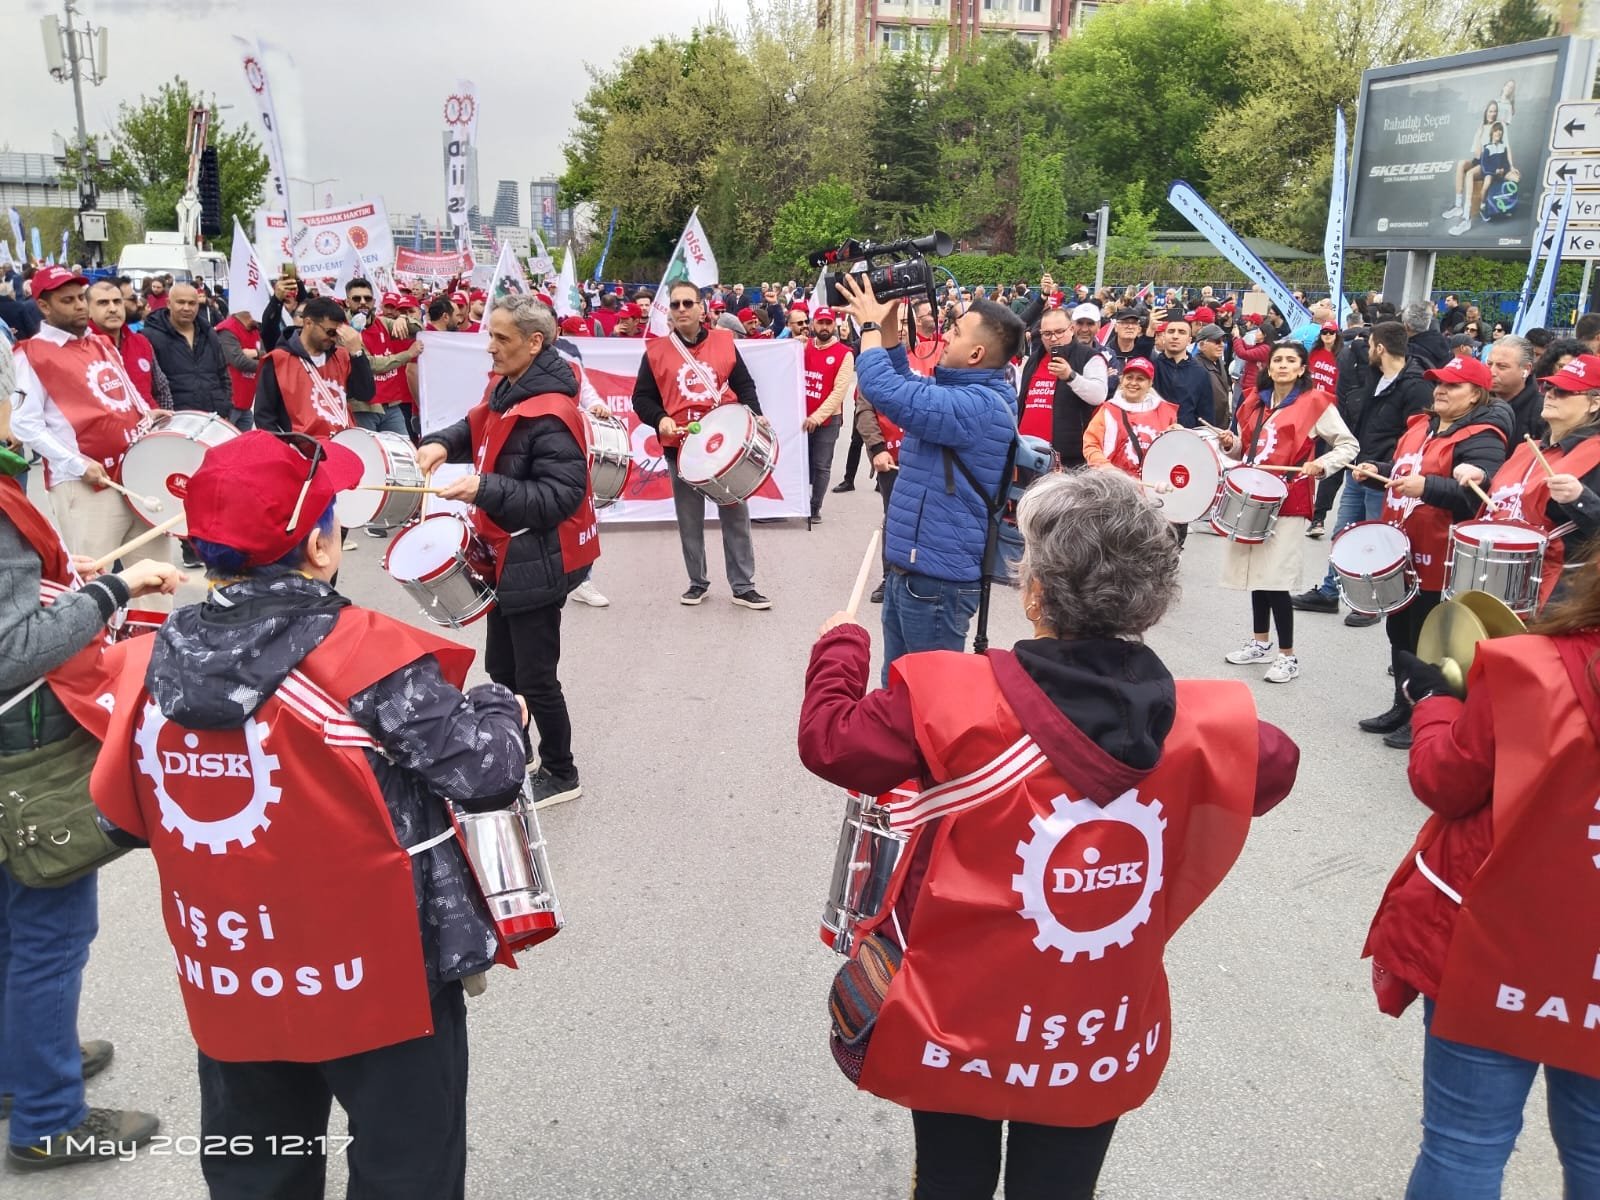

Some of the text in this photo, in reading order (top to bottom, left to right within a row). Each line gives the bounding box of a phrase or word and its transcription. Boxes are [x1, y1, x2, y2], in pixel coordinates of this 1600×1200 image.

[1395, 130, 1434, 145] Annelere
[1424, 113, 1450, 128] Seçen
[1369, 160, 1455, 177] SKECHERS
[684, 230, 706, 265] DİSK
[1569, 235, 1600, 251] Ke
[1314, 360, 1337, 374] DİSK
[162, 733, 252, 778] DİSK
[1052, 847, 1143, 894] DİSK
[173, 891, 275, 951] İŞÇİ
[1015, 995, 1129, 1050] İŞÇİ
[921, 1021, 1161, 1088] BANDOSU
